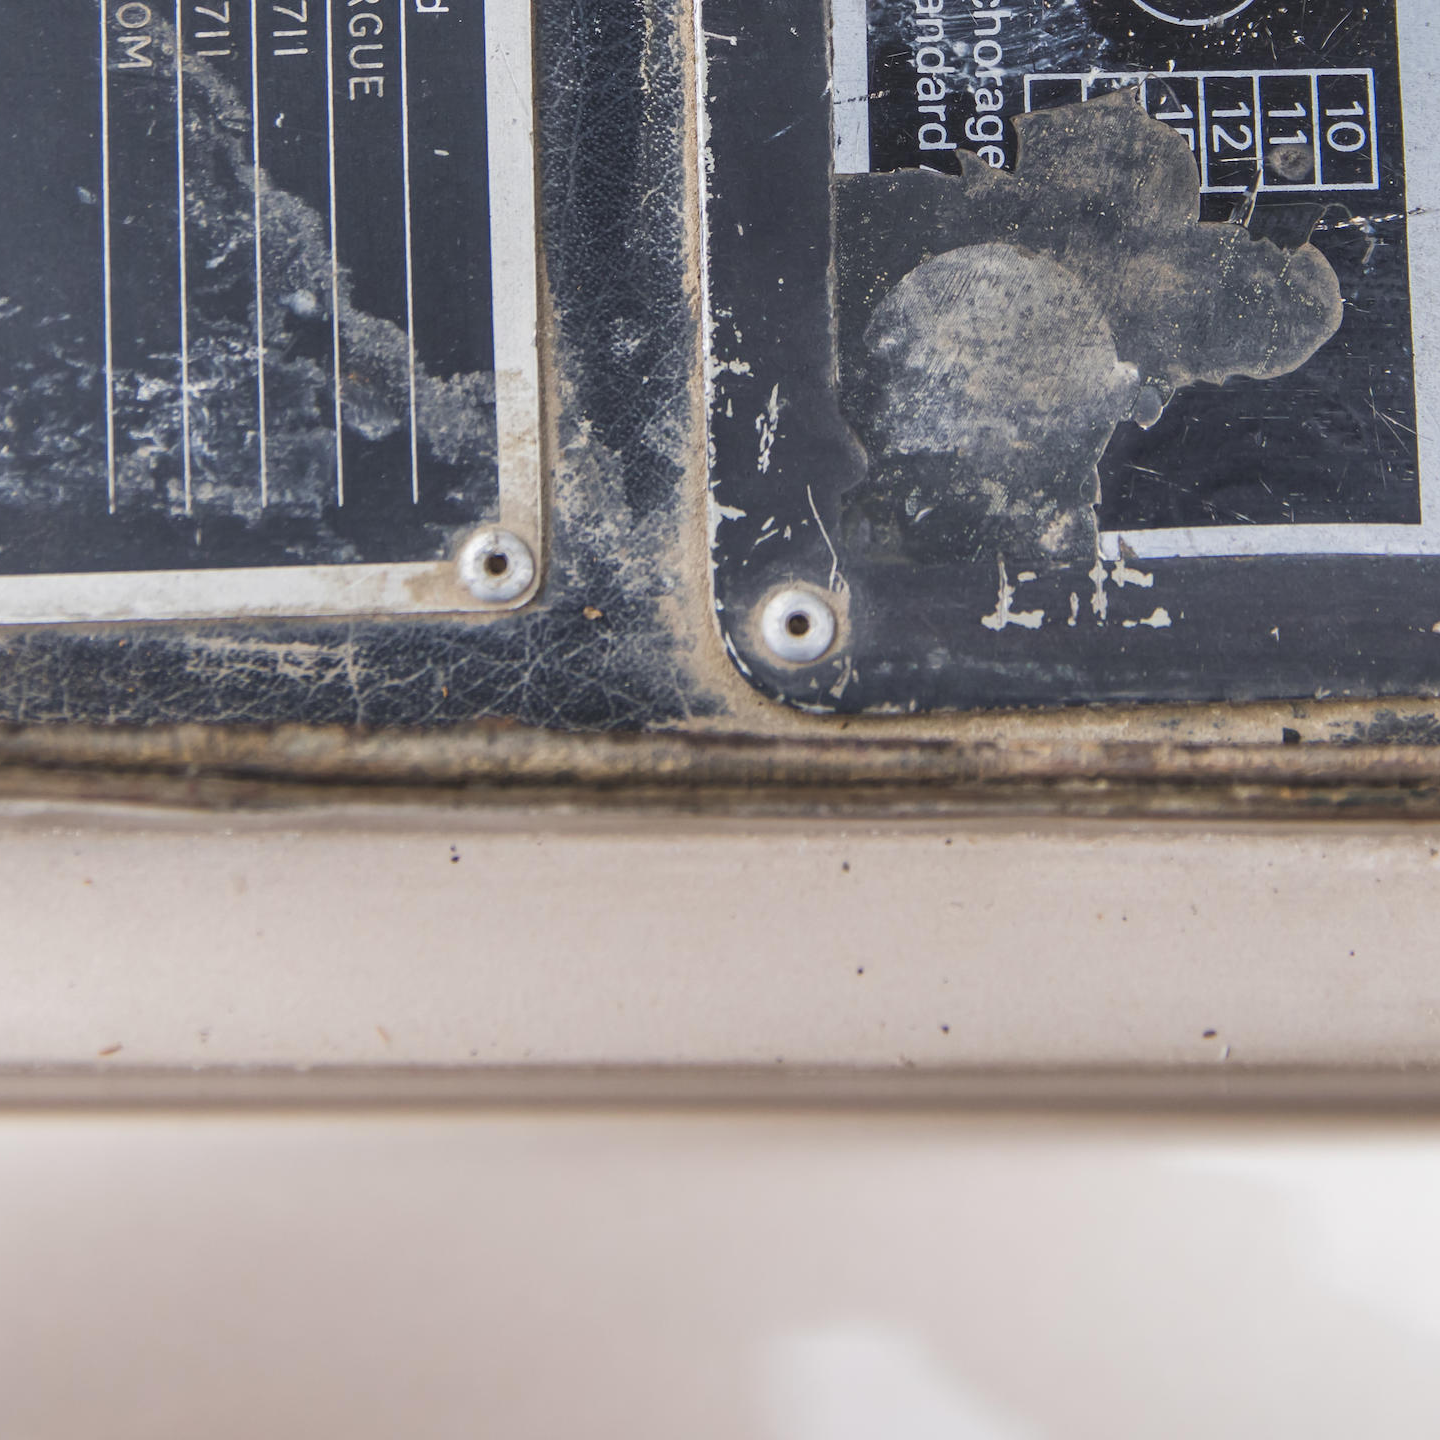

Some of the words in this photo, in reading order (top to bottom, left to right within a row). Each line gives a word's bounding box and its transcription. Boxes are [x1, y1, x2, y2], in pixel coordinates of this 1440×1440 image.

[1211, 101, 1253, 153] 12
[1267, 101, 1308, 145] 11
[1325, 101, 1366, 152] 10
